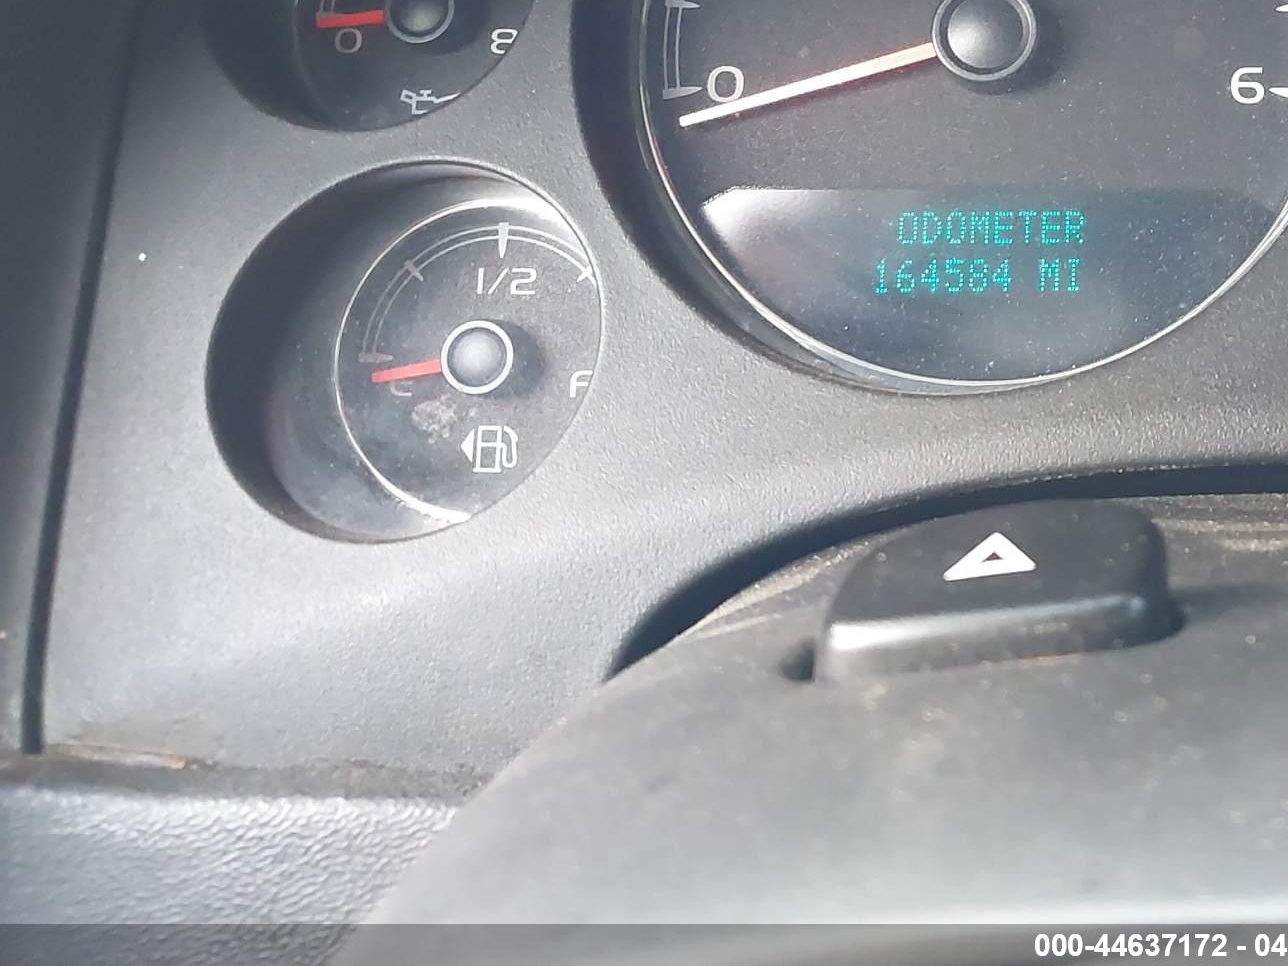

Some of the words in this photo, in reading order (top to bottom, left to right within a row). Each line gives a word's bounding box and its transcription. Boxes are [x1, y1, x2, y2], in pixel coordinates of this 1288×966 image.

[334, 27, 364, 55] 0
[705, 65, 746, 104] 0
[1230, 66, 1265, 104] 6
[898, 210, 1084, 246] ODOMETER
[476, 265, 538, 296] 1/2
[875, 257, 1012, 294] 164584
[1039, 258, 1080, 292] MI
[569, 369, 594, 399] F
